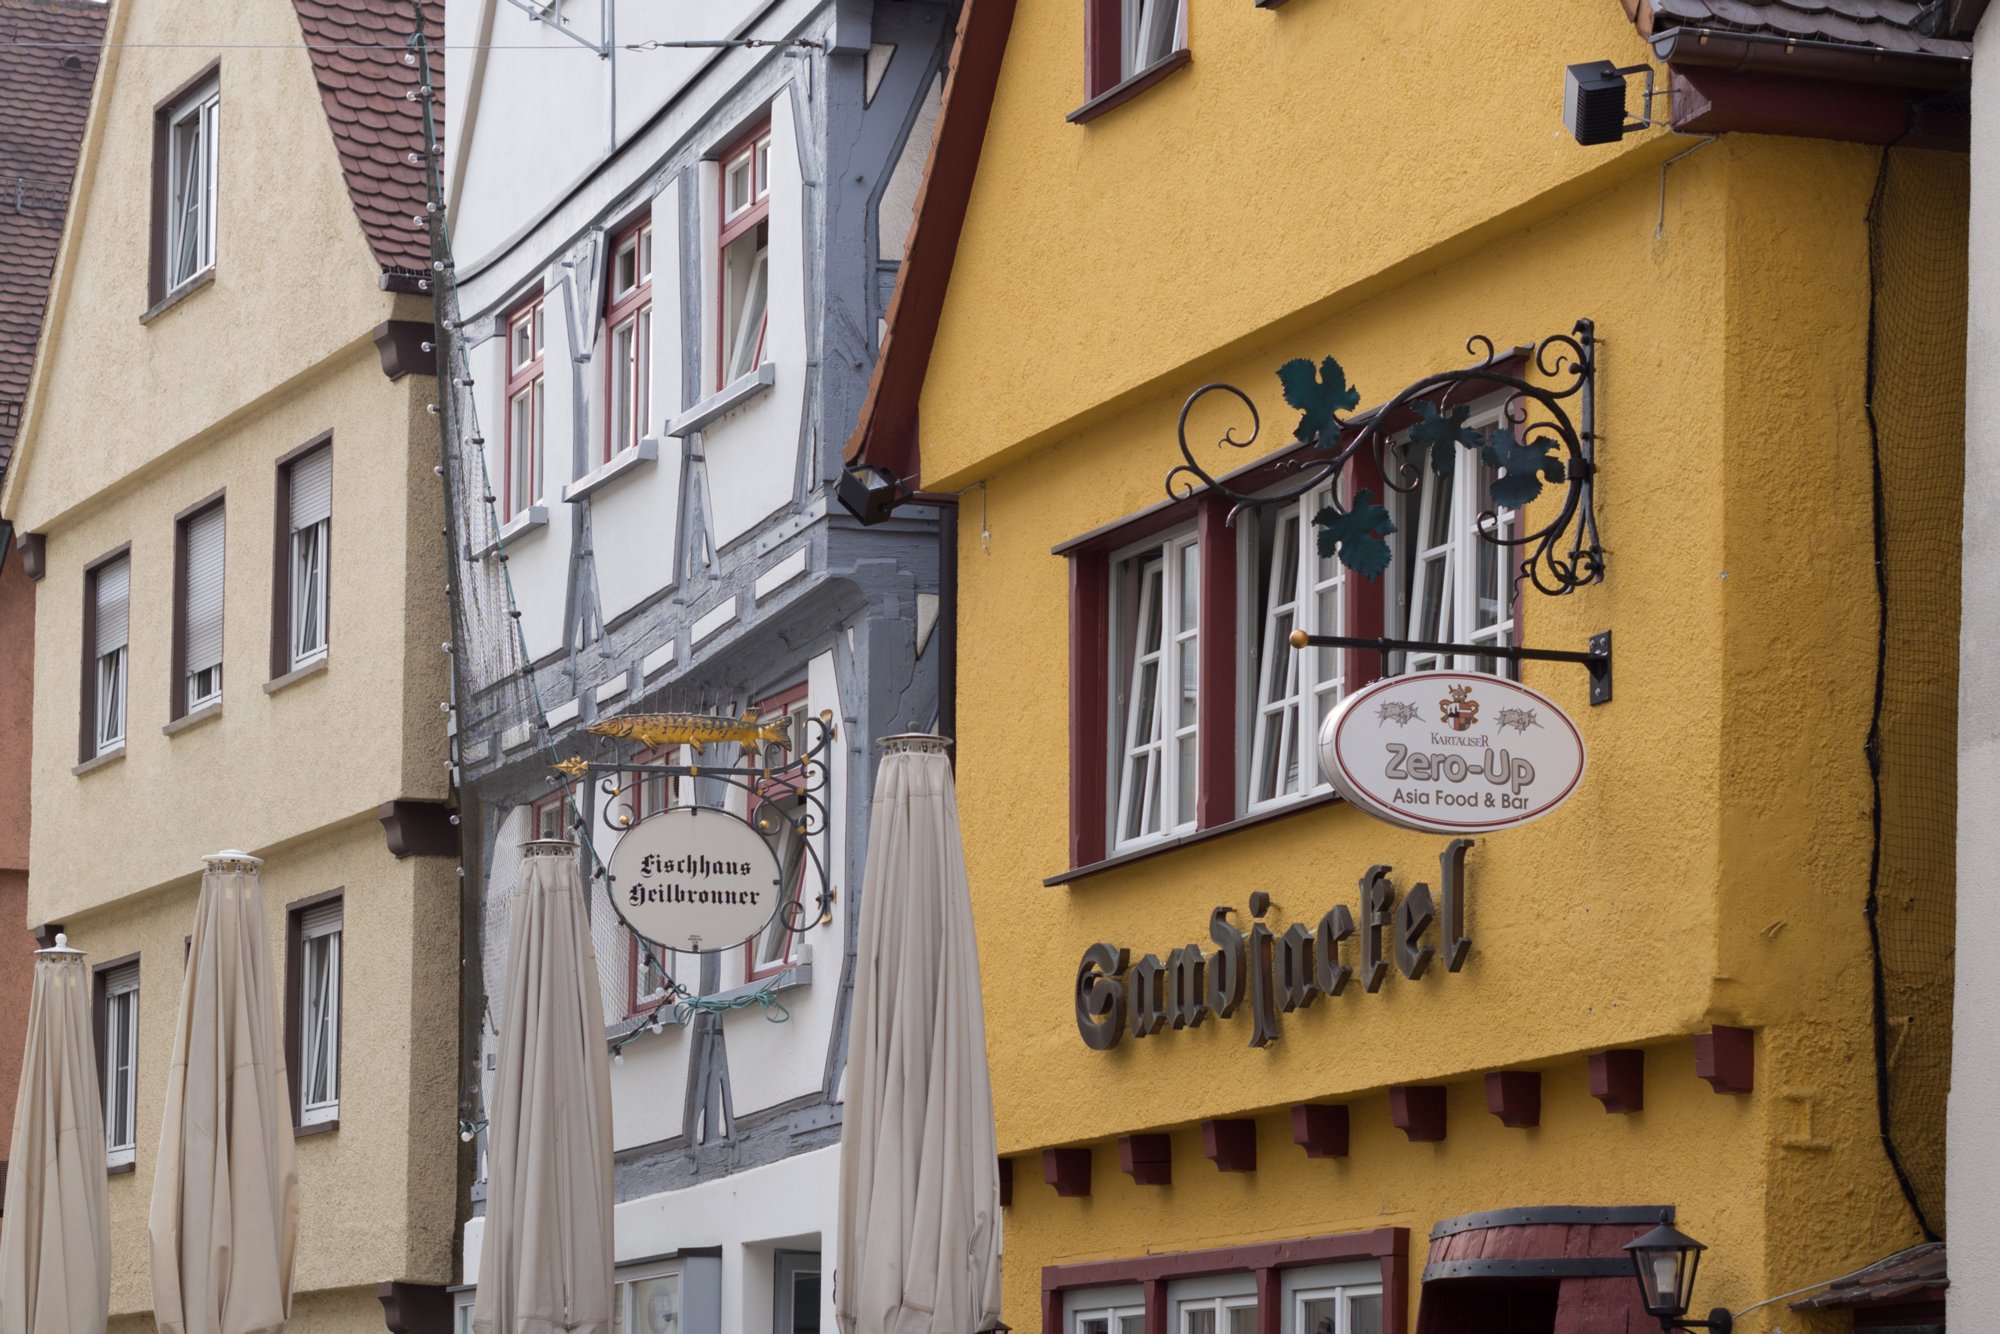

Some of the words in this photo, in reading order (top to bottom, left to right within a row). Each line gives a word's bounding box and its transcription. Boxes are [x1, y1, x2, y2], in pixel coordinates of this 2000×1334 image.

[1385, 743, 1535, 795] Zero-Up
[1393, 788, 1430, 805] Asia
[1436, 790, 1478, 807] Food
[1484, 792, 1496, 807] &
[1502, 793, 1529, 810] Bar
[640, 854, 751, 879] Fischhaus
[629, 883, 760, 907] Heilbronner
